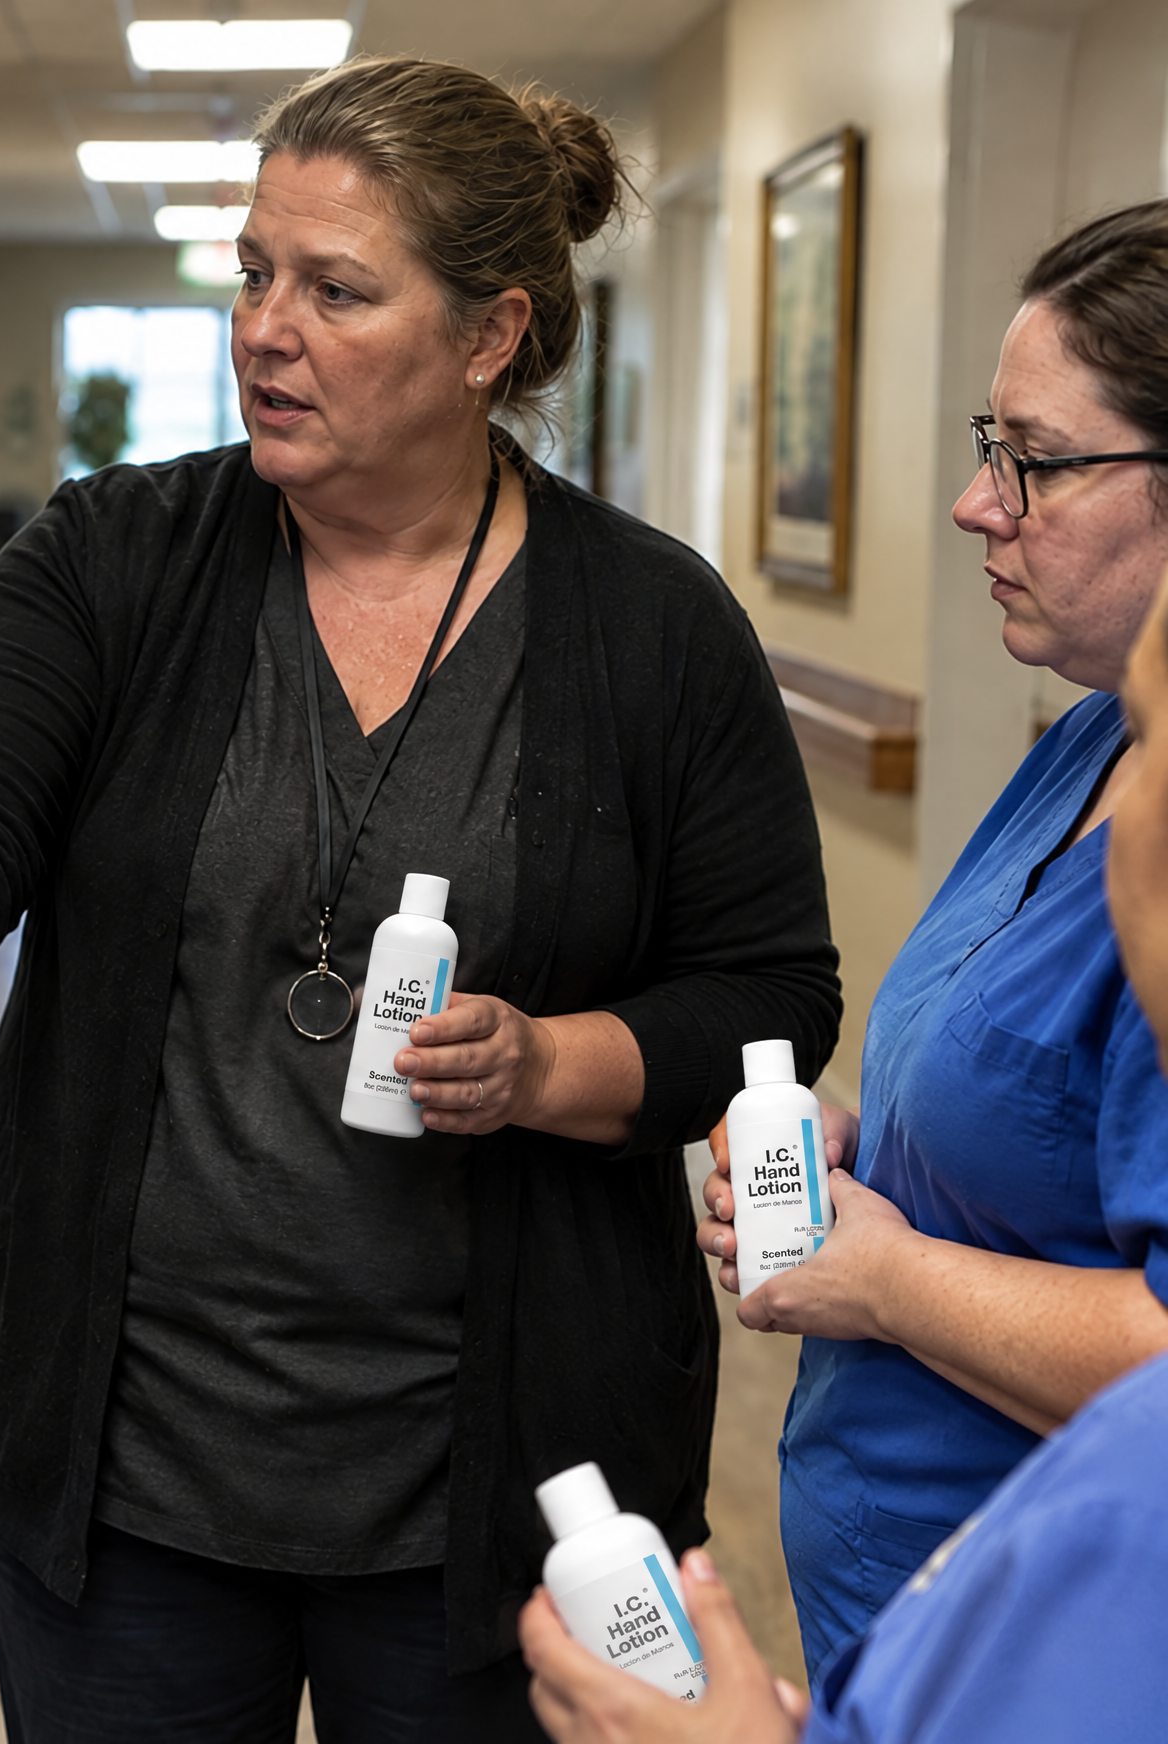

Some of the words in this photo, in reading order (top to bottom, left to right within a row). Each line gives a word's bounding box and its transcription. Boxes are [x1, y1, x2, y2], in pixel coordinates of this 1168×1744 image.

[383, 990, 426, 1010] Hand
[369, 1070, 408, 1085] Scented
[754, 1162, 800, 1180] Hand
[748, 1180, 802, 1197] Lotion
[762, 1246, 804, 1259] Scented
[607, 1605, 661, 1640] Hand
[606, 1624, 669, 1659] Lotion
